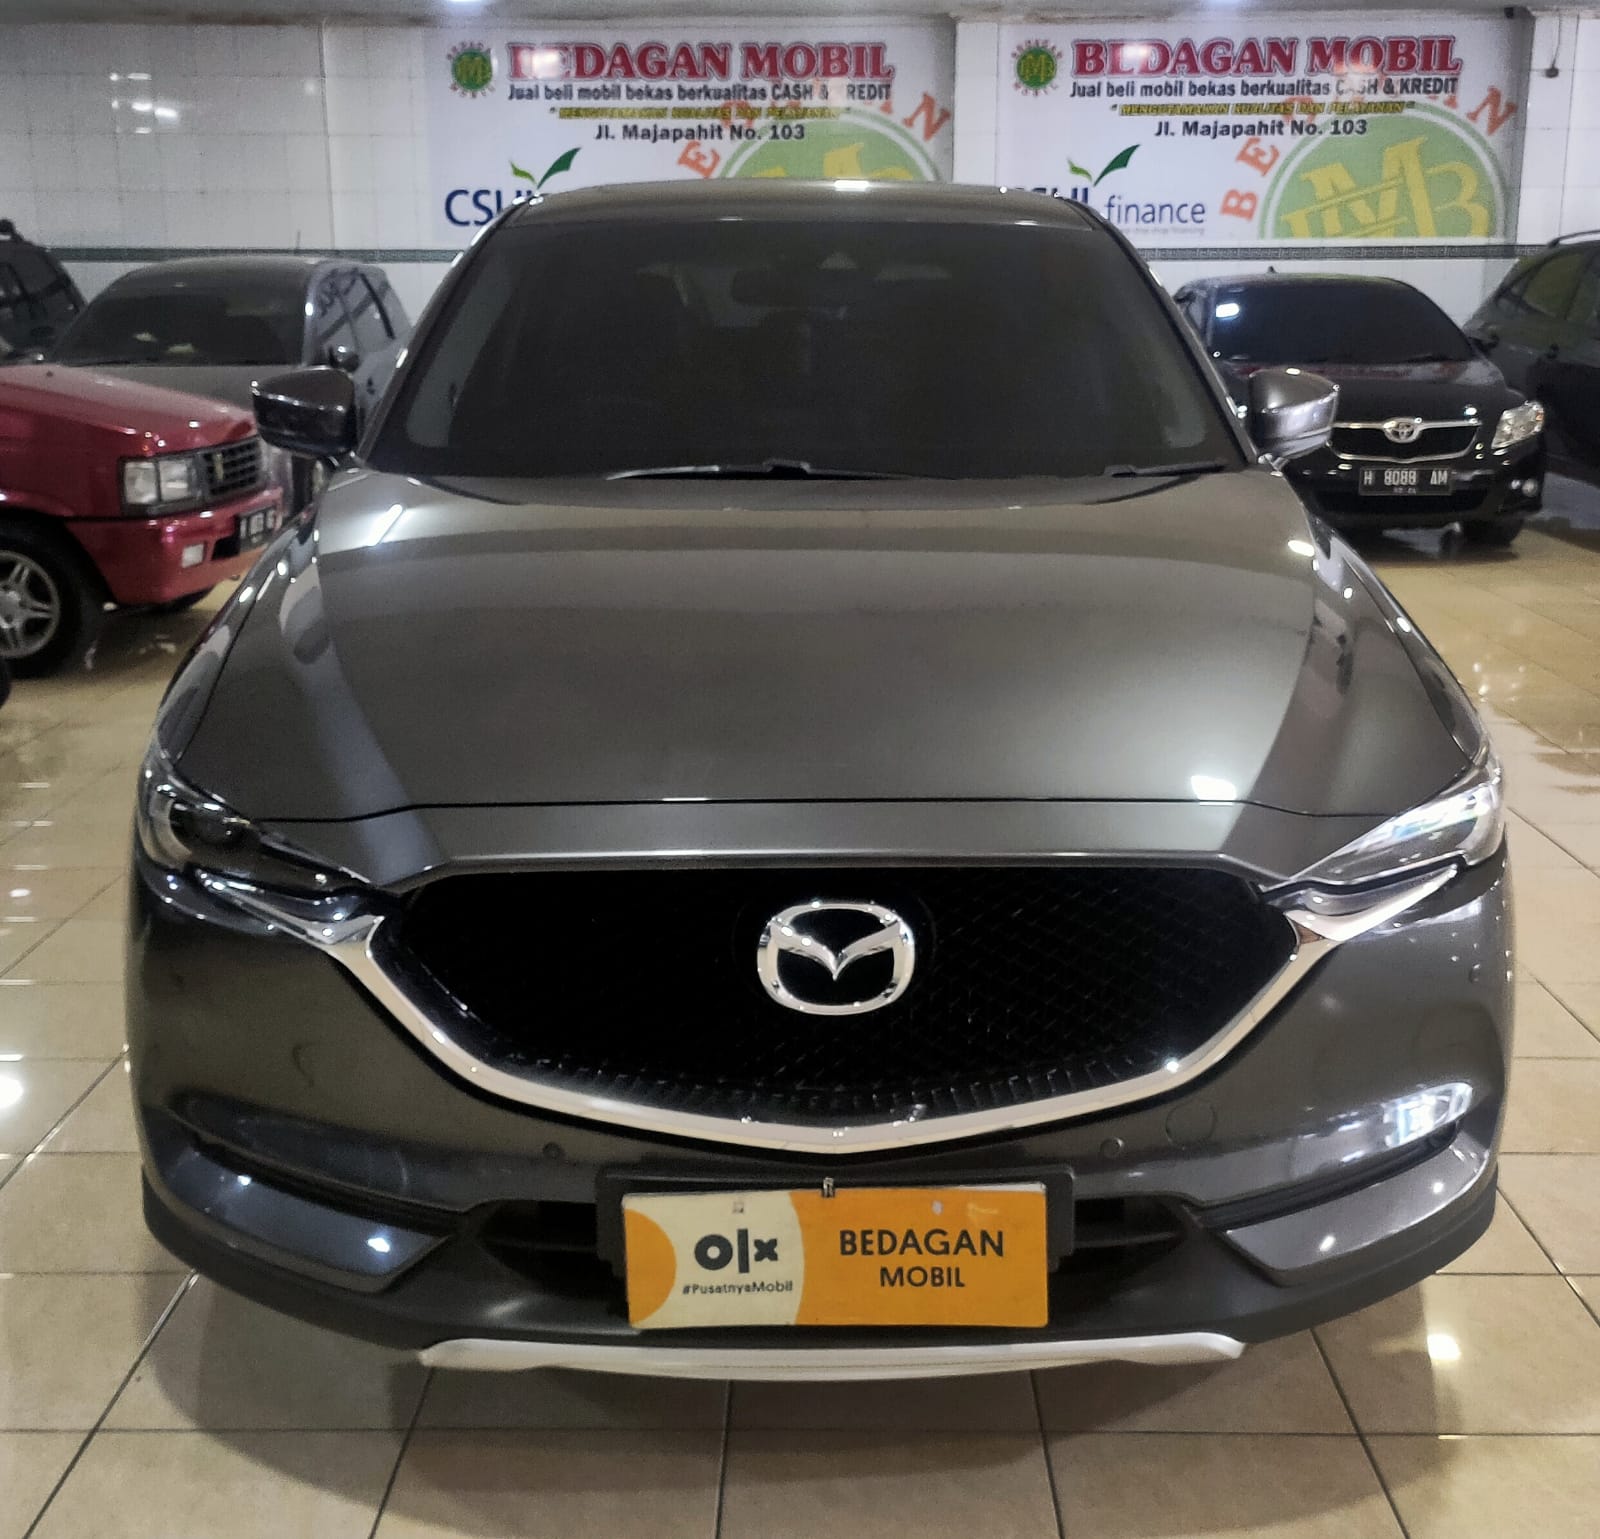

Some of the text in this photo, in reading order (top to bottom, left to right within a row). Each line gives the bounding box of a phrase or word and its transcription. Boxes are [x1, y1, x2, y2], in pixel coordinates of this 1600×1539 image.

[741, 42, 895, 81] MOBIL
[1306, 35, 1462, 76] MOBIL
[508, 84, 540, 100] Jual
[544, 84, 573, 100] beli
[577, 84, 621, 100] mobil
[625, 84, 673, 100] bekas
[677, 84, 767, 100] berkualitas
[772, 83, 813, 100] CASH
[847, 83, 891, 100] REDIT
[1070, 81, 1100, 98] Jual
[1106, 81, 1134, 97] beli
[1140, 80, 1183, 97] mobil
[1188, 80, 1236, 97] bekas
[1240, 79, 1330, 97] berkualitas
[1382, 78, 1395, 95] &
[1399, 77, 1459, 95] KREDIT
[594, 123, 805, 142] Jl. Majapahit No. 103
[1154, 118, 1368, 138] Jl. Majapahit No. 103
[1105, 194, 1206, 224] finance
[1363, 470, 1374, 486] H
[694, 1228, 779, 1274] olx
[839, 1228, 1004, 1258] BEDAGAN
[682, 1280, 794, 1295] #PusatnyaMobil
[879, 1265, 966, 1288] MOBIL
